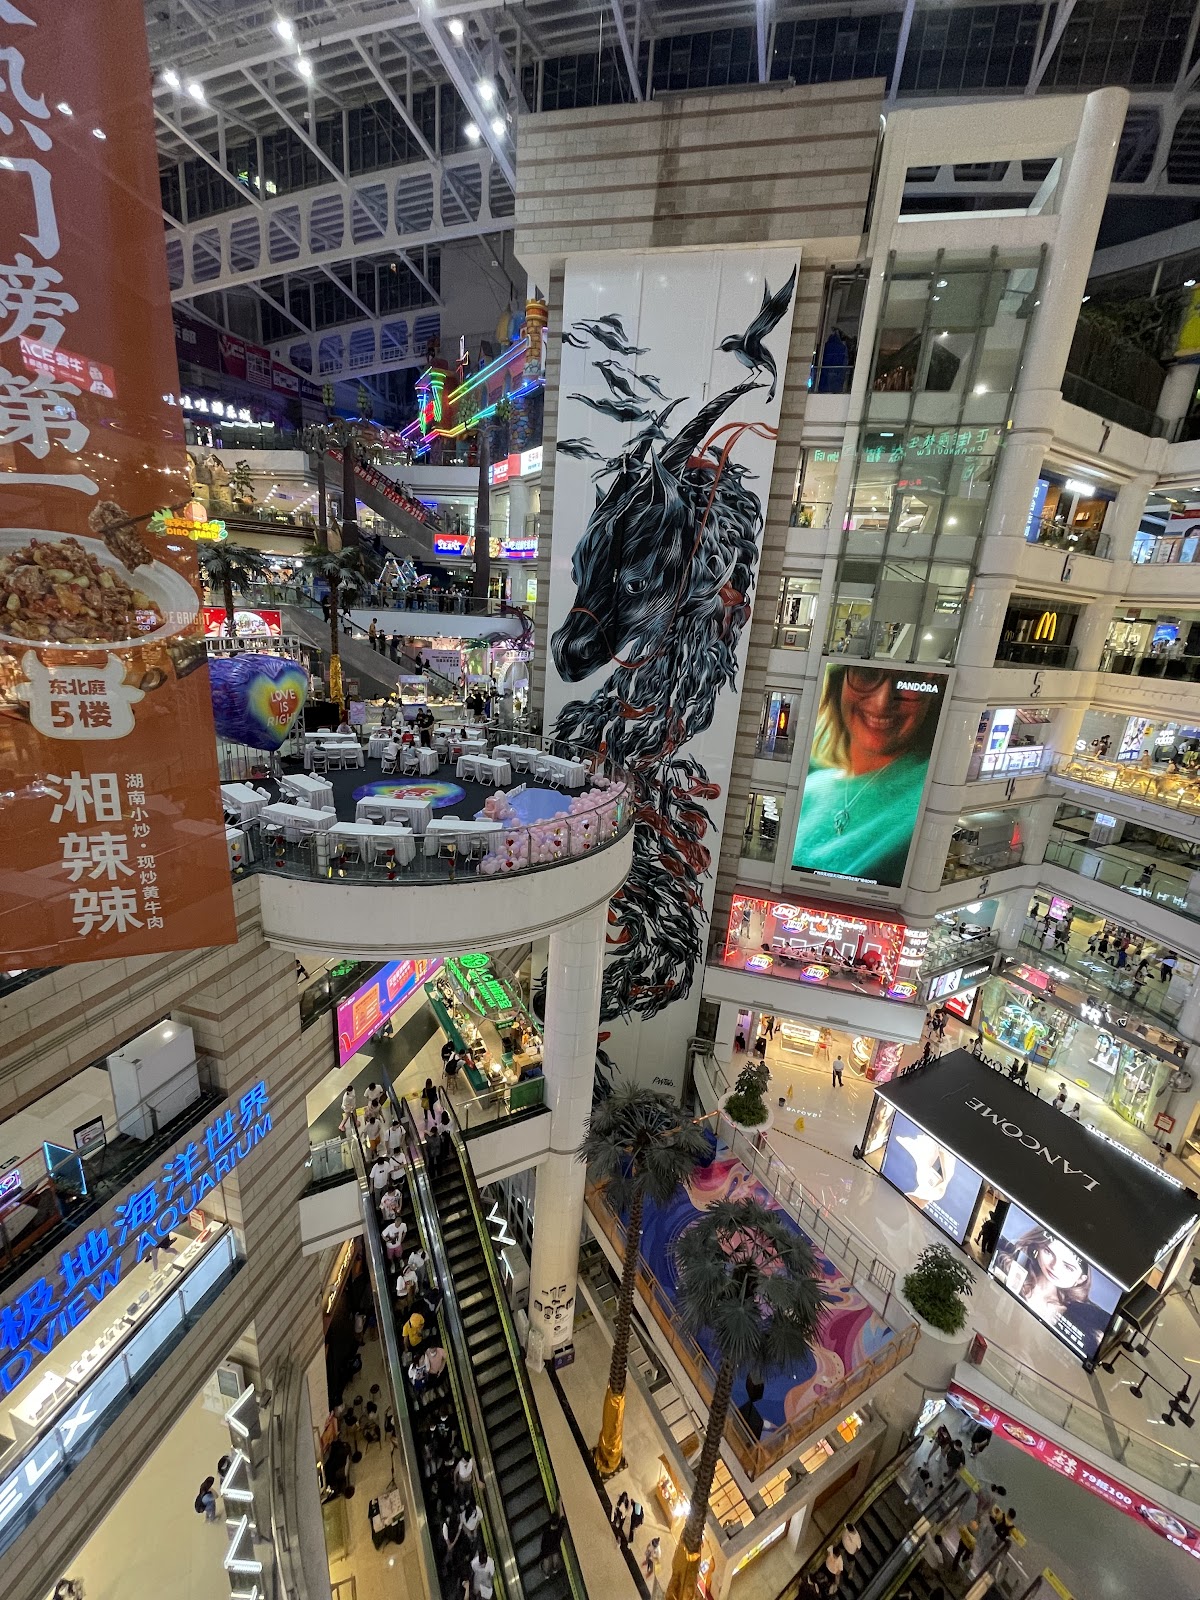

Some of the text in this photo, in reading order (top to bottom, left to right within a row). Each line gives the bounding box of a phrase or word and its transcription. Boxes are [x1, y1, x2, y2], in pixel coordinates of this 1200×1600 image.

[48, 679, 107, 696] 东北庭
[50, 700, 112, 728] 5楼
[270, 688, 296, 702] LOVE
[280, 701, 289, 713] IS
[45, 770, 145, 936] 湘辣辣
[964, 1096, 1101, 1193] LANCOME
[0, 1079, 269, 1351] 极地海洋世界
[136, 1111, 274, 1263] AQUARIUM
